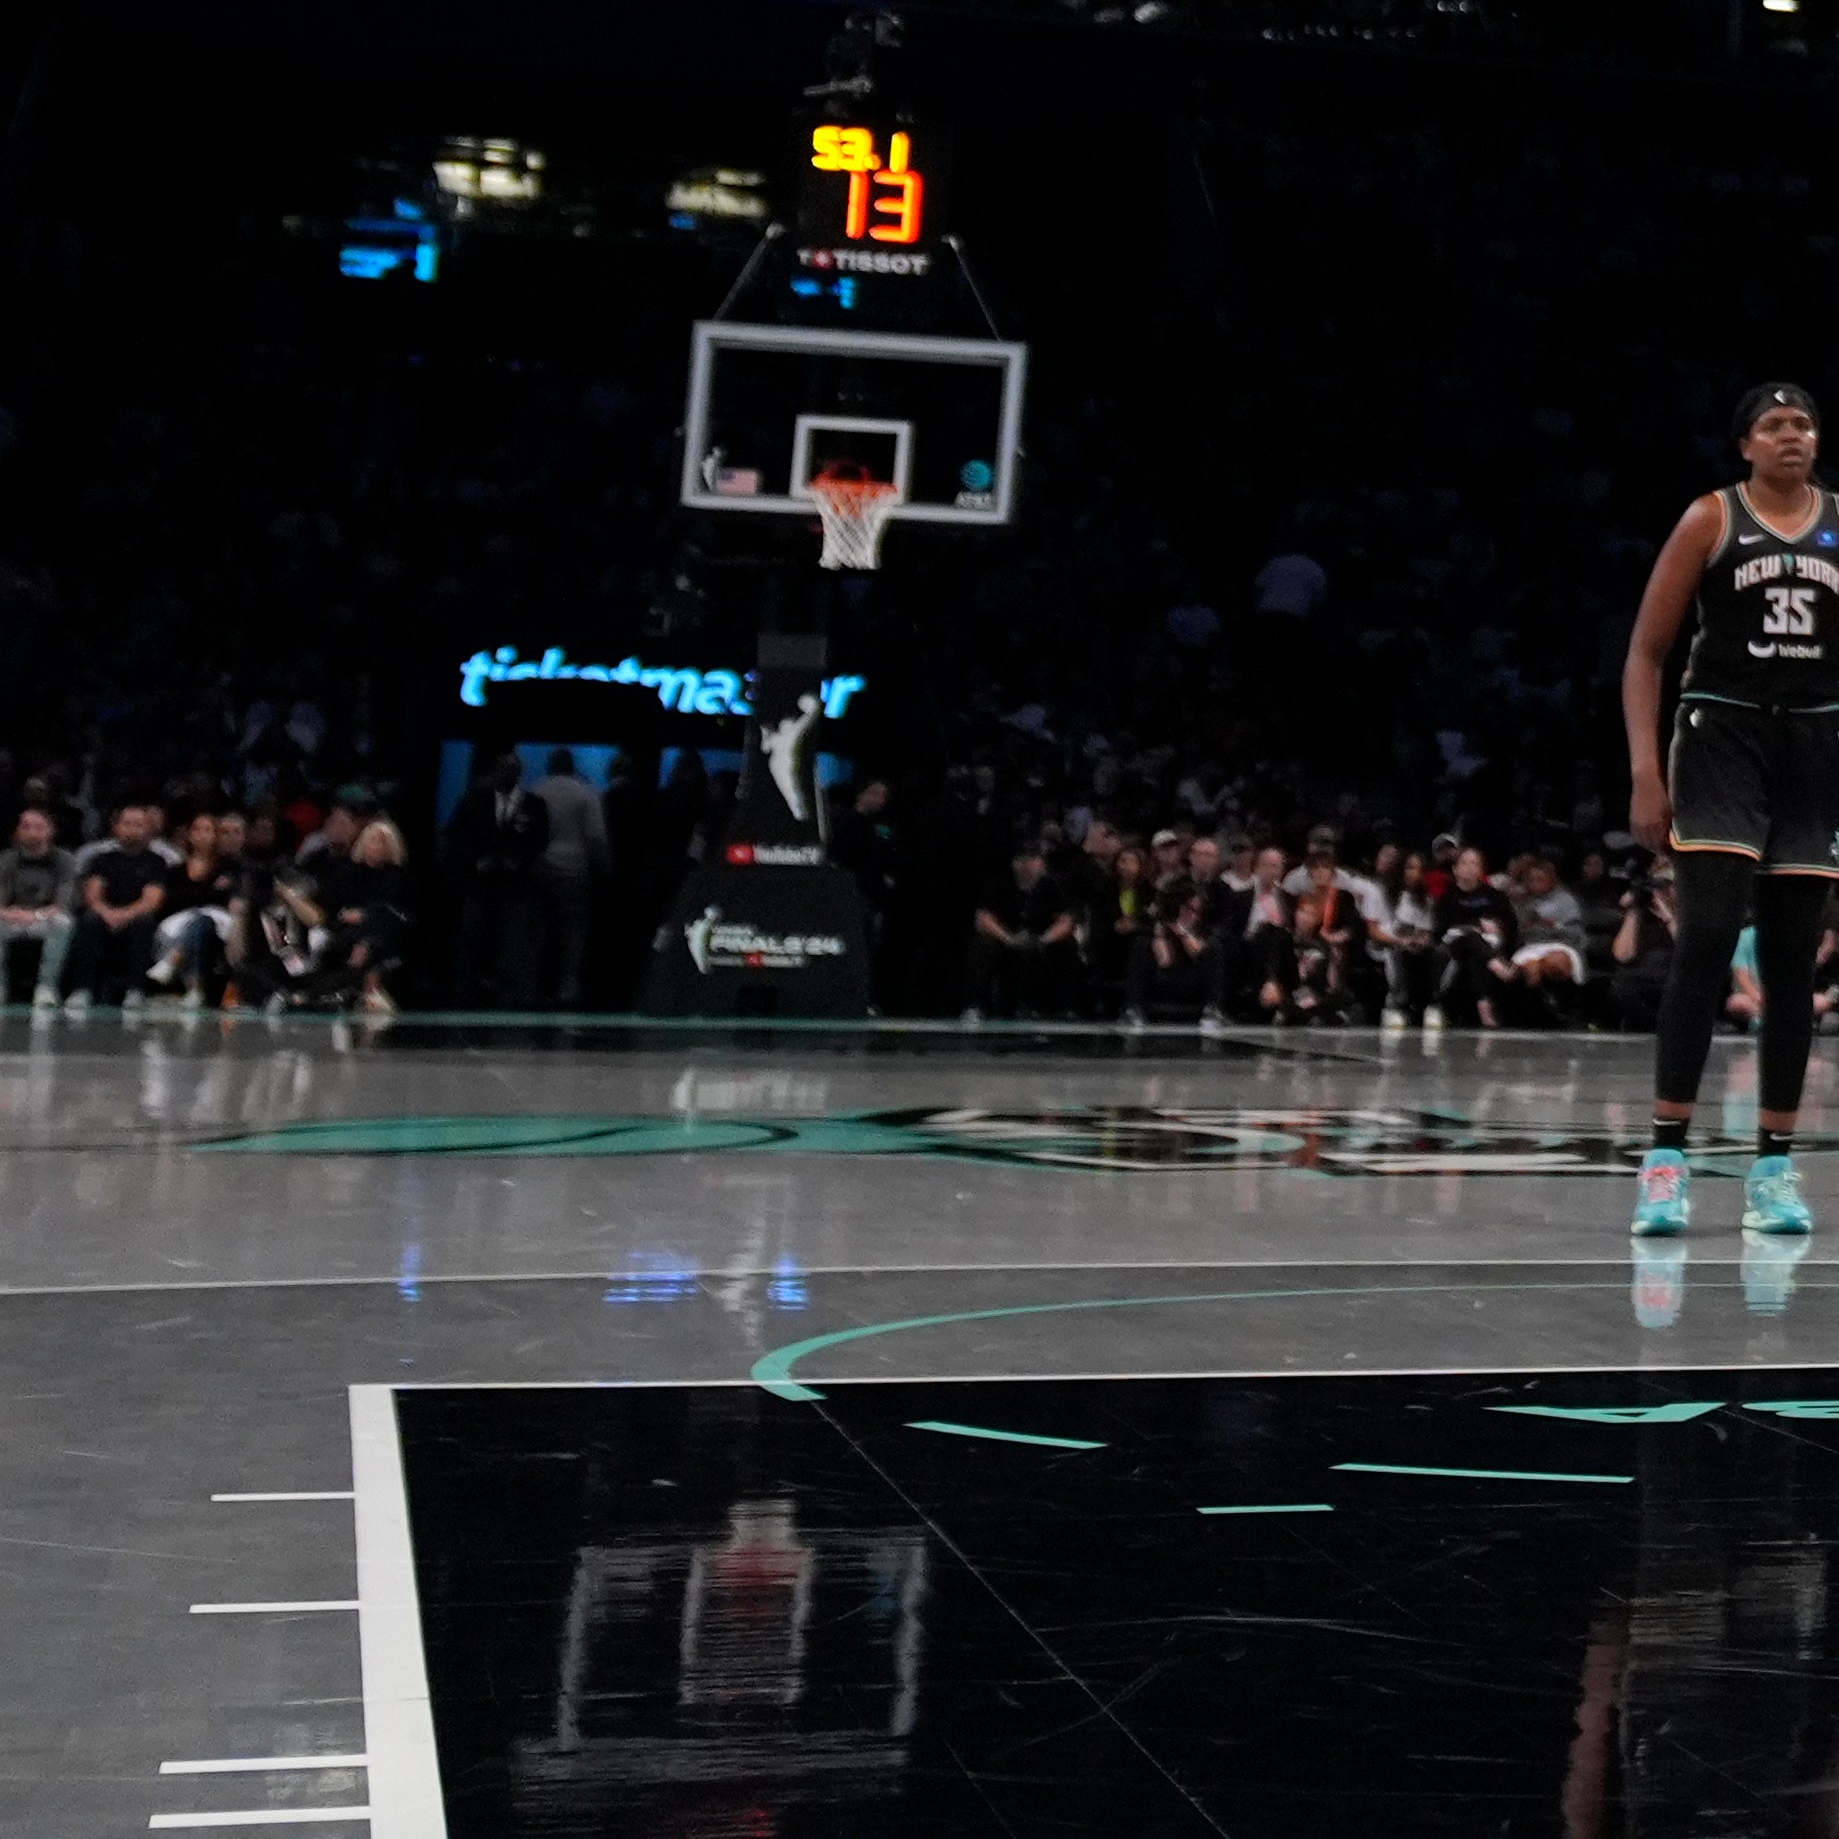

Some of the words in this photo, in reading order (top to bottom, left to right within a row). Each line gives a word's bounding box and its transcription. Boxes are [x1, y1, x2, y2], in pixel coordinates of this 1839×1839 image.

[811, 125, 910, 173] 53.1
[1734, 554, 1781, 591] NEW
[1763, 587, 1816, 636] 35
[1778, 643, 1823, 660] Webull
